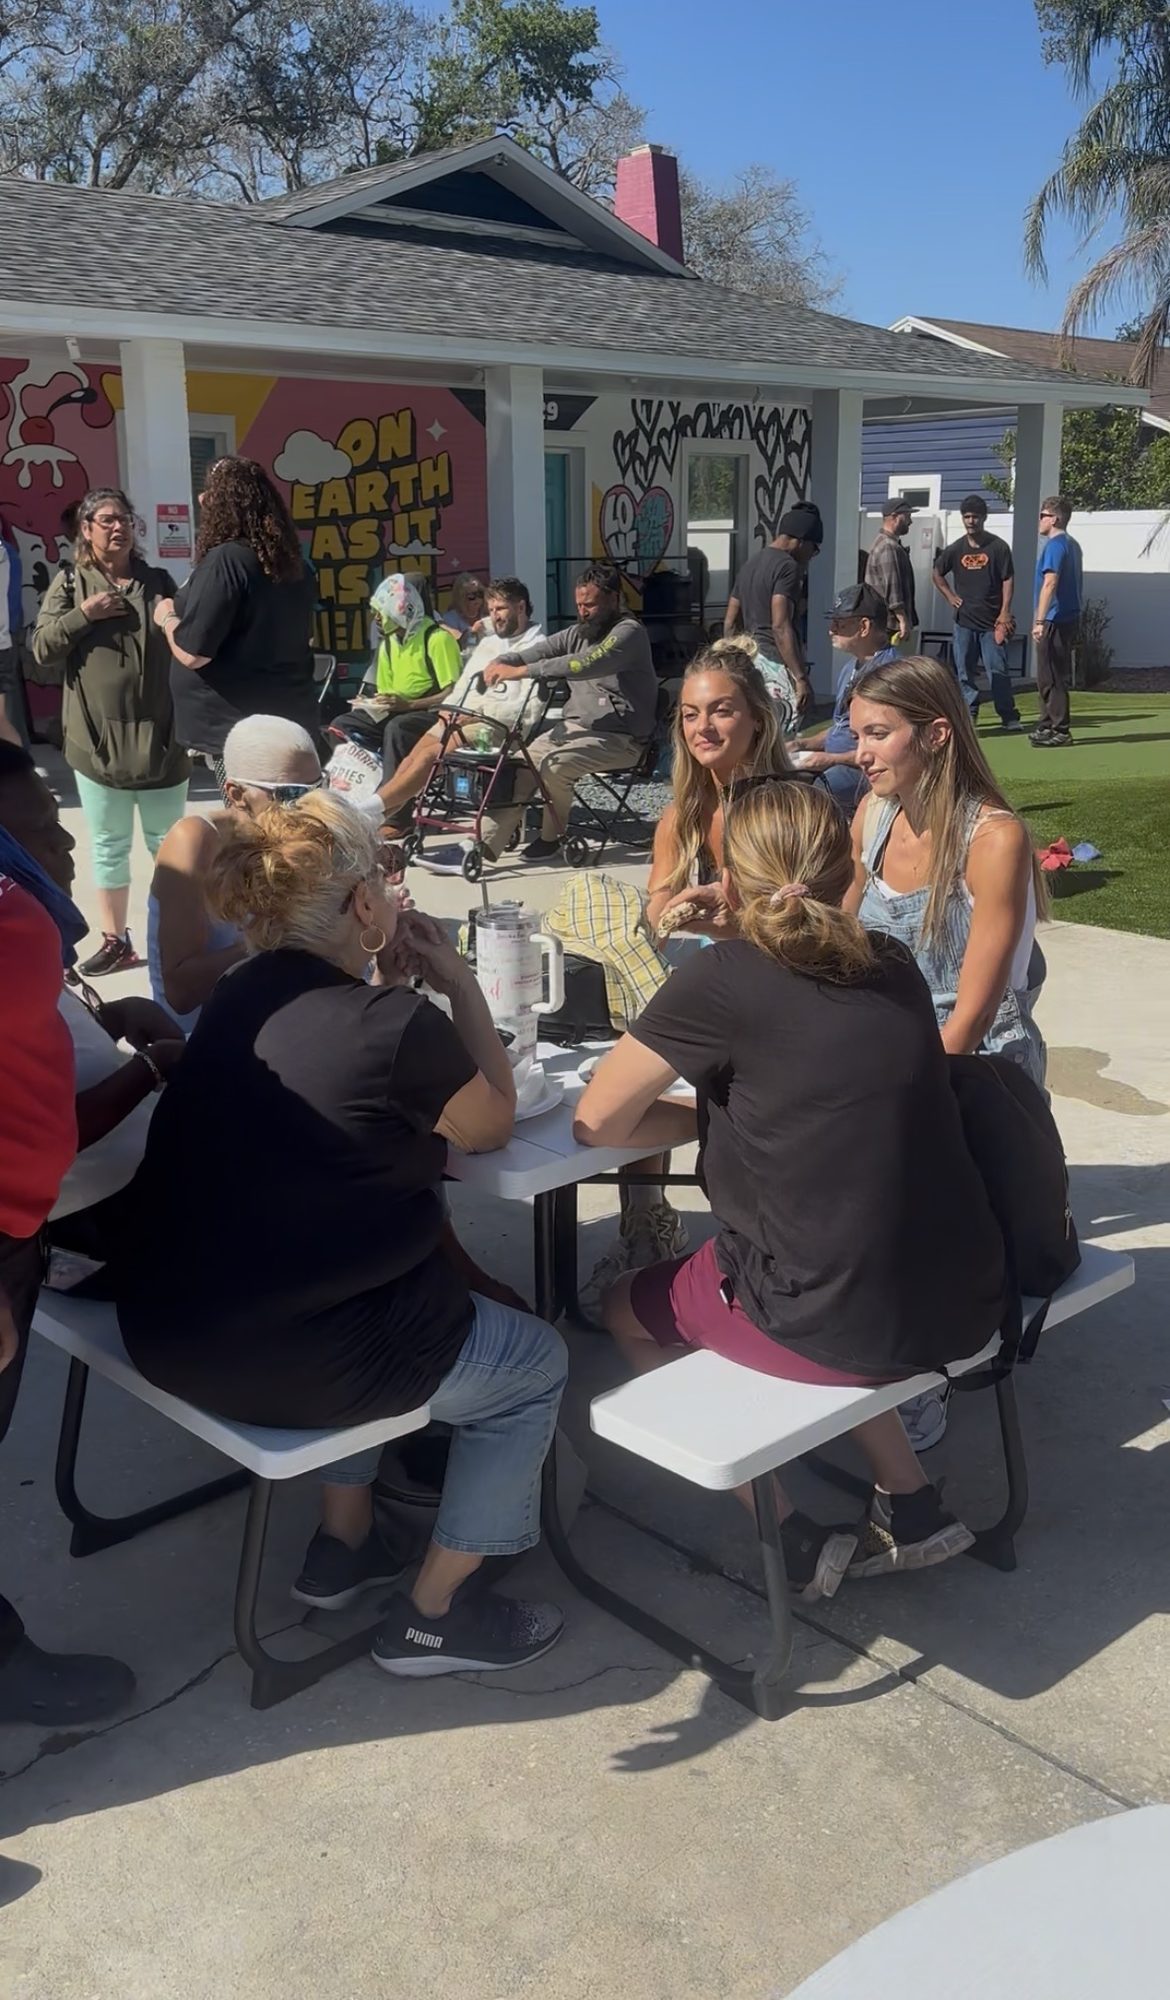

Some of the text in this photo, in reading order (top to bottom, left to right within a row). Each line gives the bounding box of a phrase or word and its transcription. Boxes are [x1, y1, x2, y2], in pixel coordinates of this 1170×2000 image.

[543, 401, 559, 421] 9
[335, 407, 411, 467] ON
[291, 451, 450, 520] EARTH
[311, 508, 437, 560] AS IT
[319, 564, 369, 604] IS
[404, 1626, 444, 1649] PUMA
